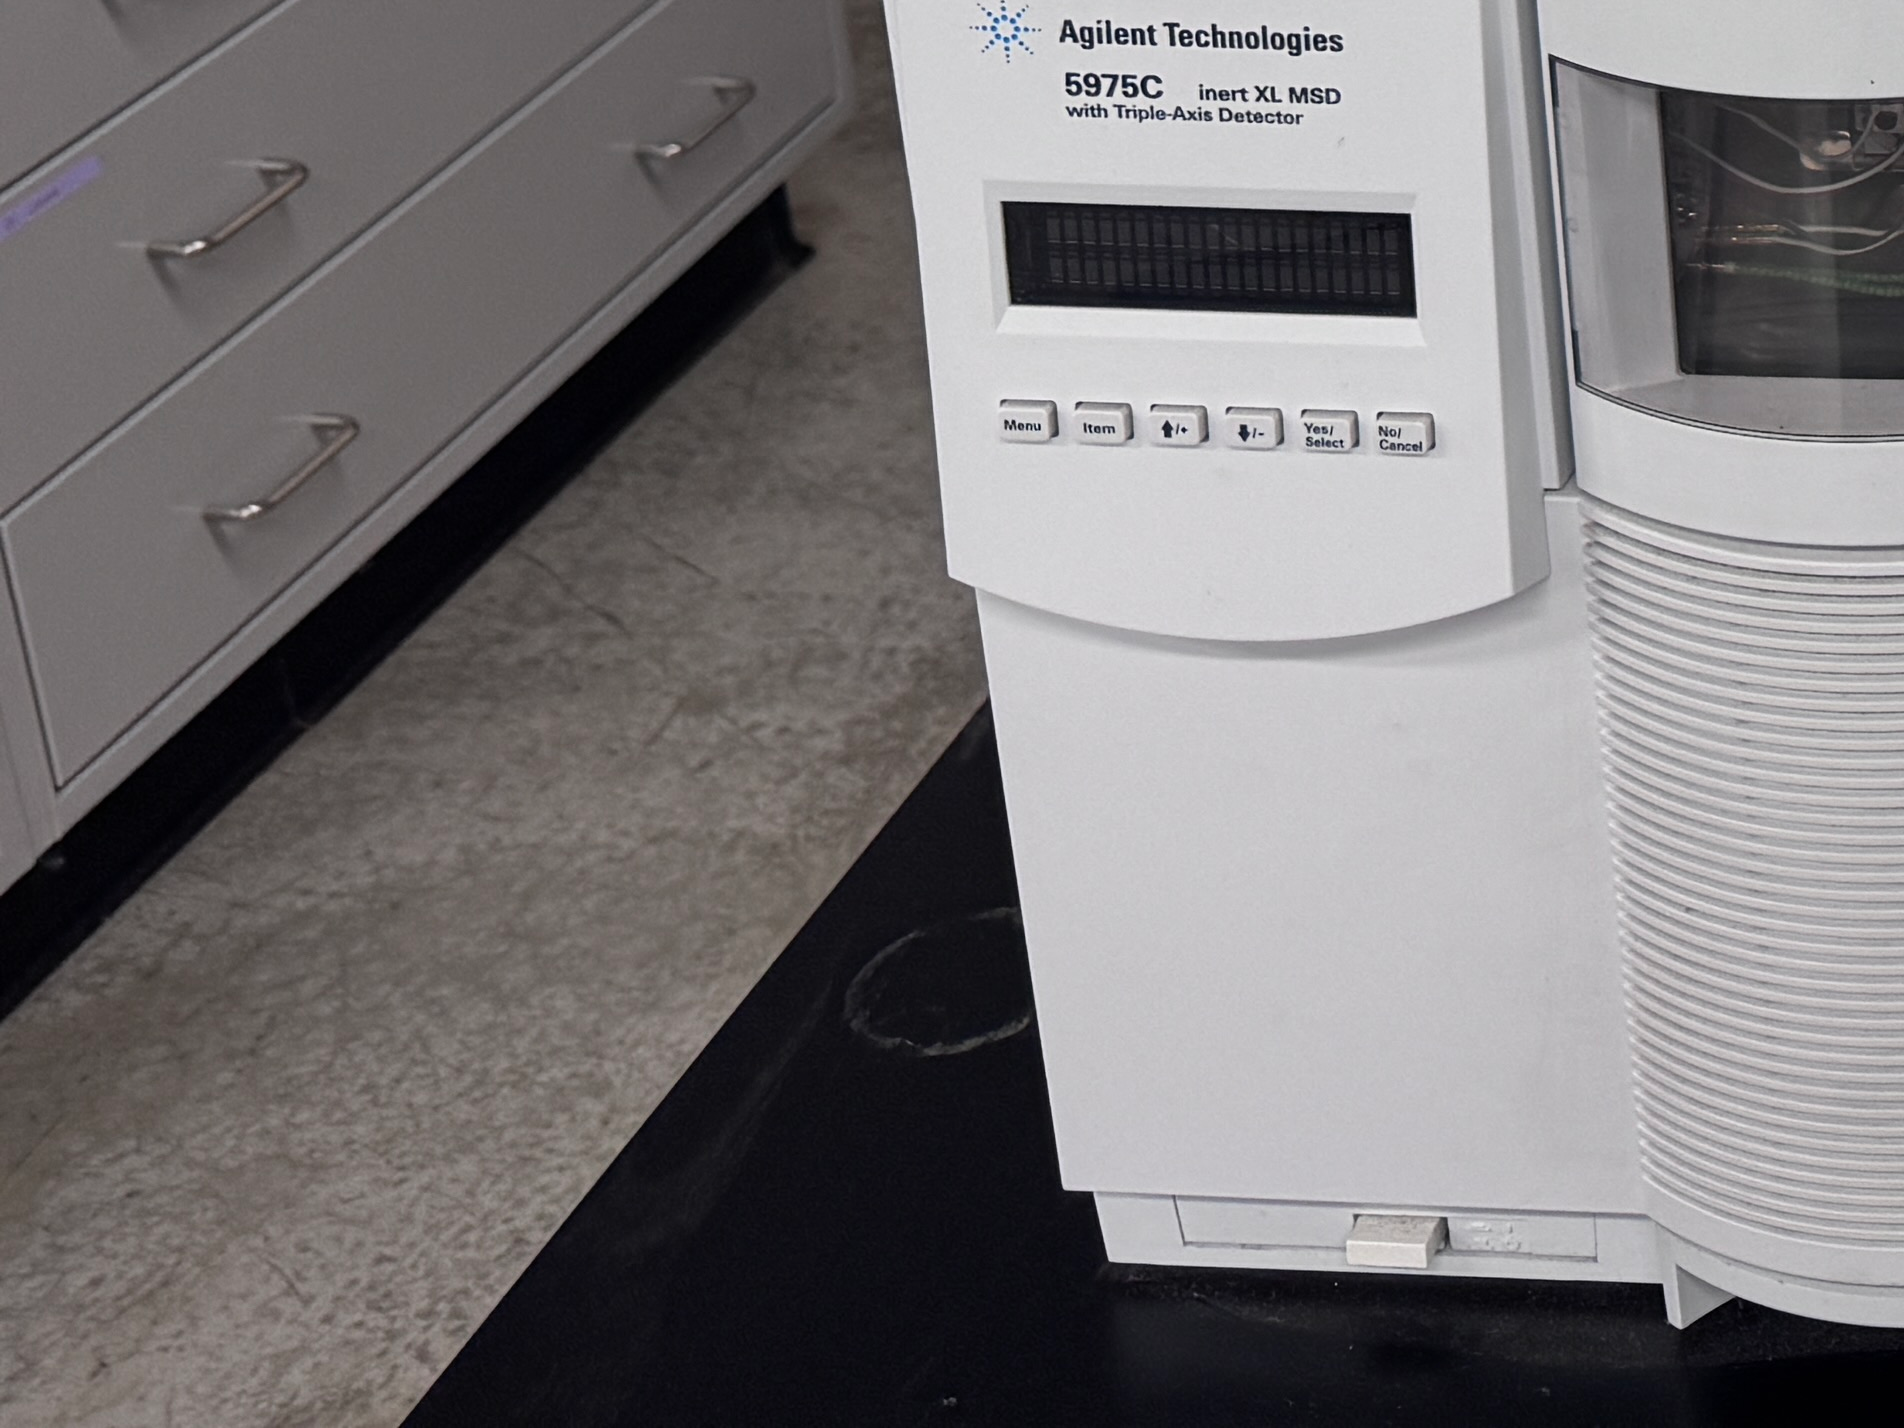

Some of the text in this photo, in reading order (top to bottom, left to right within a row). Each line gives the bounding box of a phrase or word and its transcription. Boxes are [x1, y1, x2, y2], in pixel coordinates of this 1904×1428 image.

[1059, 19, 1344, 57] Agilent Technologies
[1064, 71, 1342, 105] 5975C inert XL MSD
[1065, 103, 1304, 125] with Triple-Axis Detector
[1003, 419, 1042, 432] Menu
[1082, 422, 1116, 435] Item
[1303, 422, 1334, 437] Yes/
[1378, 425, 1402, 439] No/
[1305, 436, 1344, 449] Select
[1379, 438, 1423, 452] Cancel
